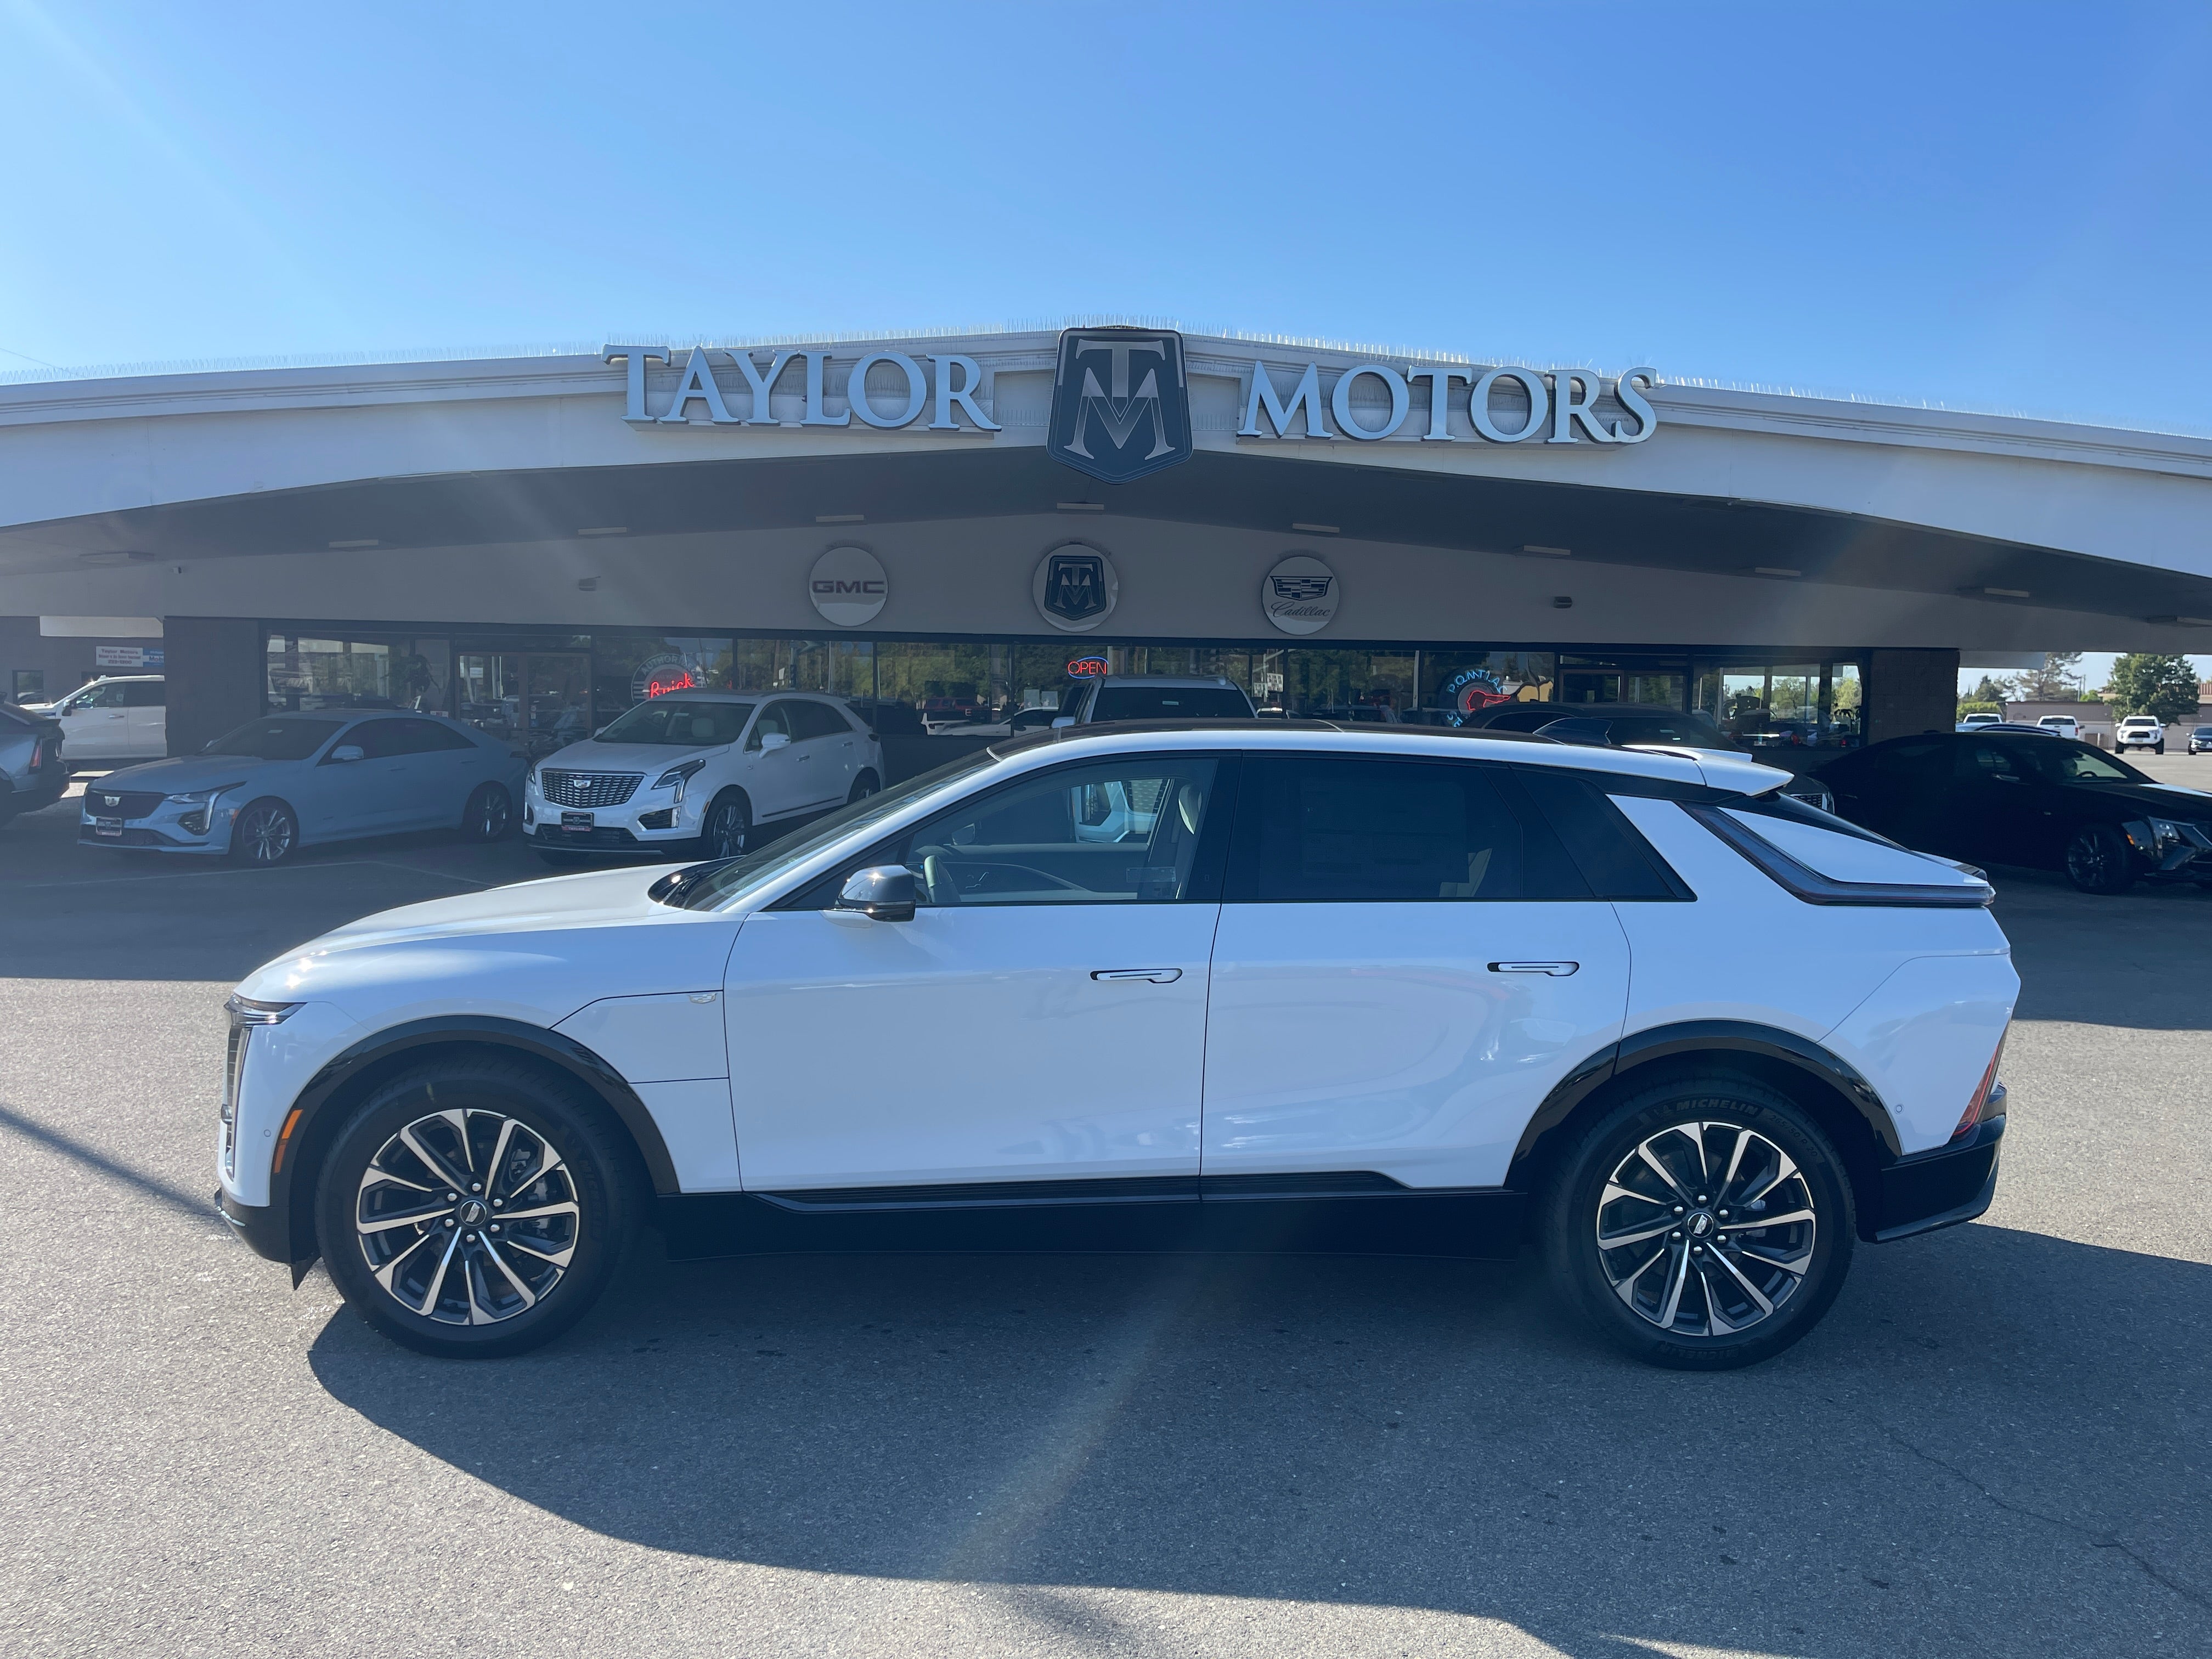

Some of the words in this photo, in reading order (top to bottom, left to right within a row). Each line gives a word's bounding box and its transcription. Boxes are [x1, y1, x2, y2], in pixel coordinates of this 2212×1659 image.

[602, 343, 1002, 431] TAYLOR
[1235, 360, 1657, 444] MOTORS
[811, 580, 885, 594] GMC
[1271, 601, 1330, 618] Cadillac
[1068, 661, 1107, 675] OPEN
[1447, 669, 1508, 693] PONTIAC
[1676, 1099, 1758, 1115] MICHELIN
